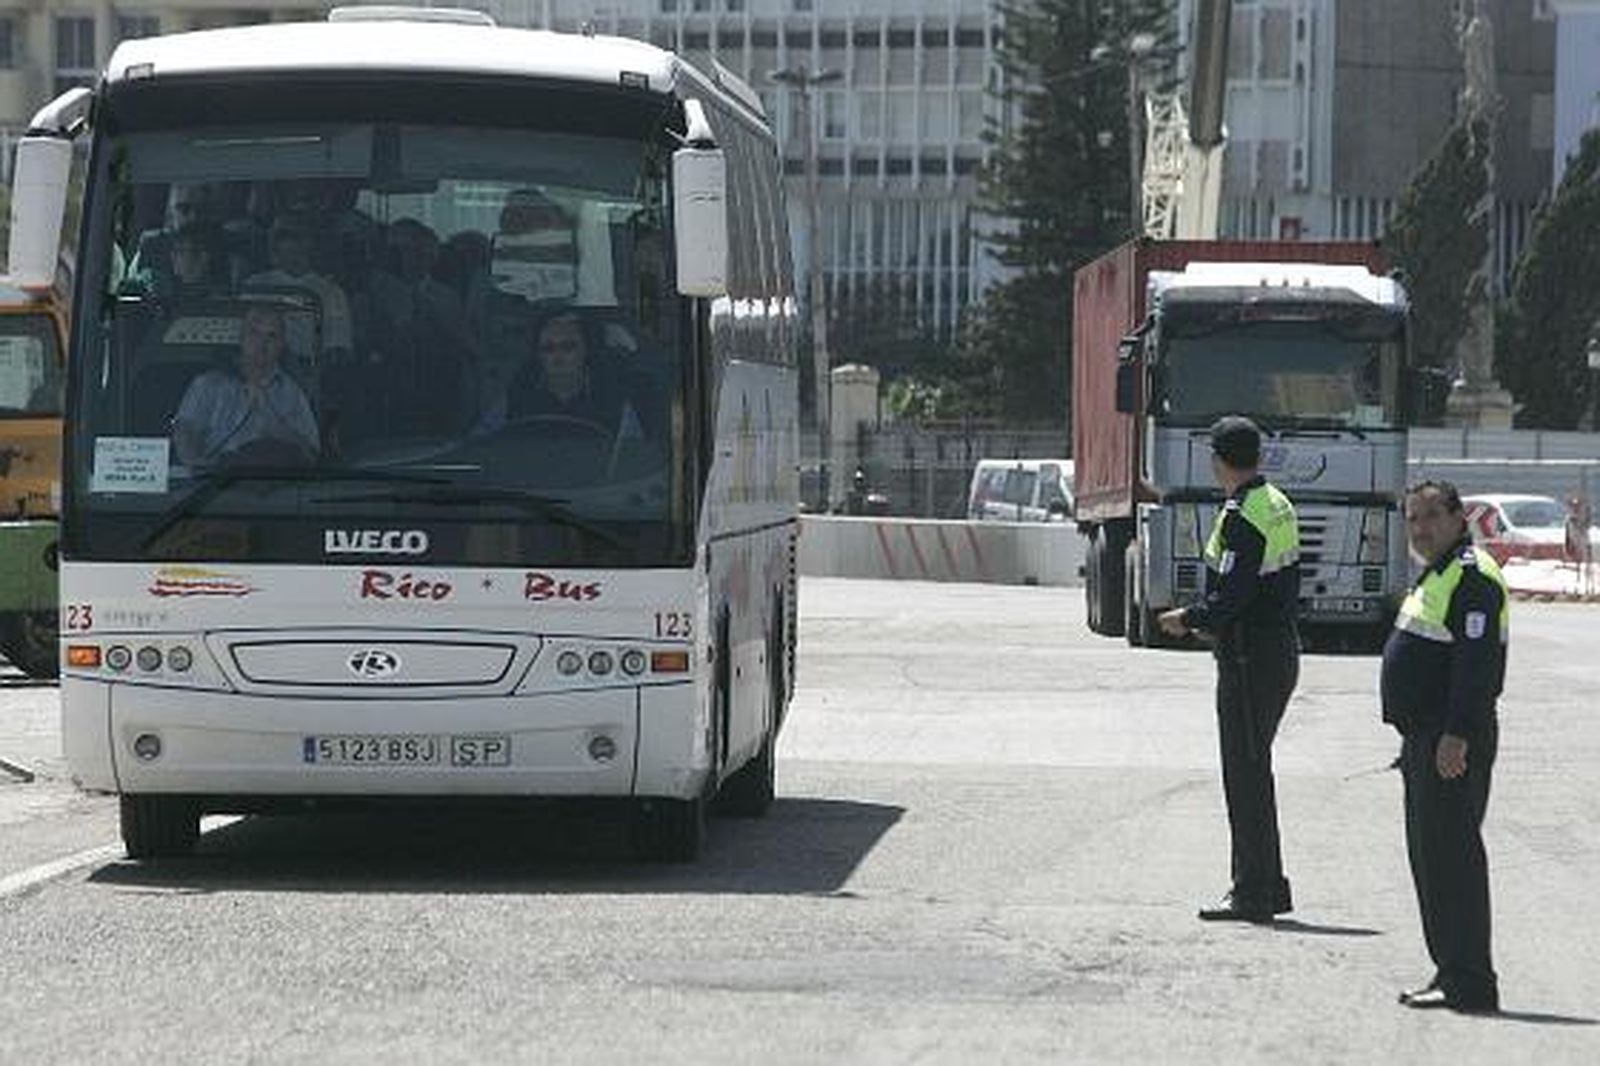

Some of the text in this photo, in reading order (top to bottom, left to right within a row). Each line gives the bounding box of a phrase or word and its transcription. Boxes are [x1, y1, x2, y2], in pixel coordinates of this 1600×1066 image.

[324, 530, 428, 555] IVECO
[361, 570, 602, 601] Rico Bus
[654, 611, 692, 637] 123
[319, 738, 434, 762] 5123 BSJ
[458, 741, 501, 764] SP
